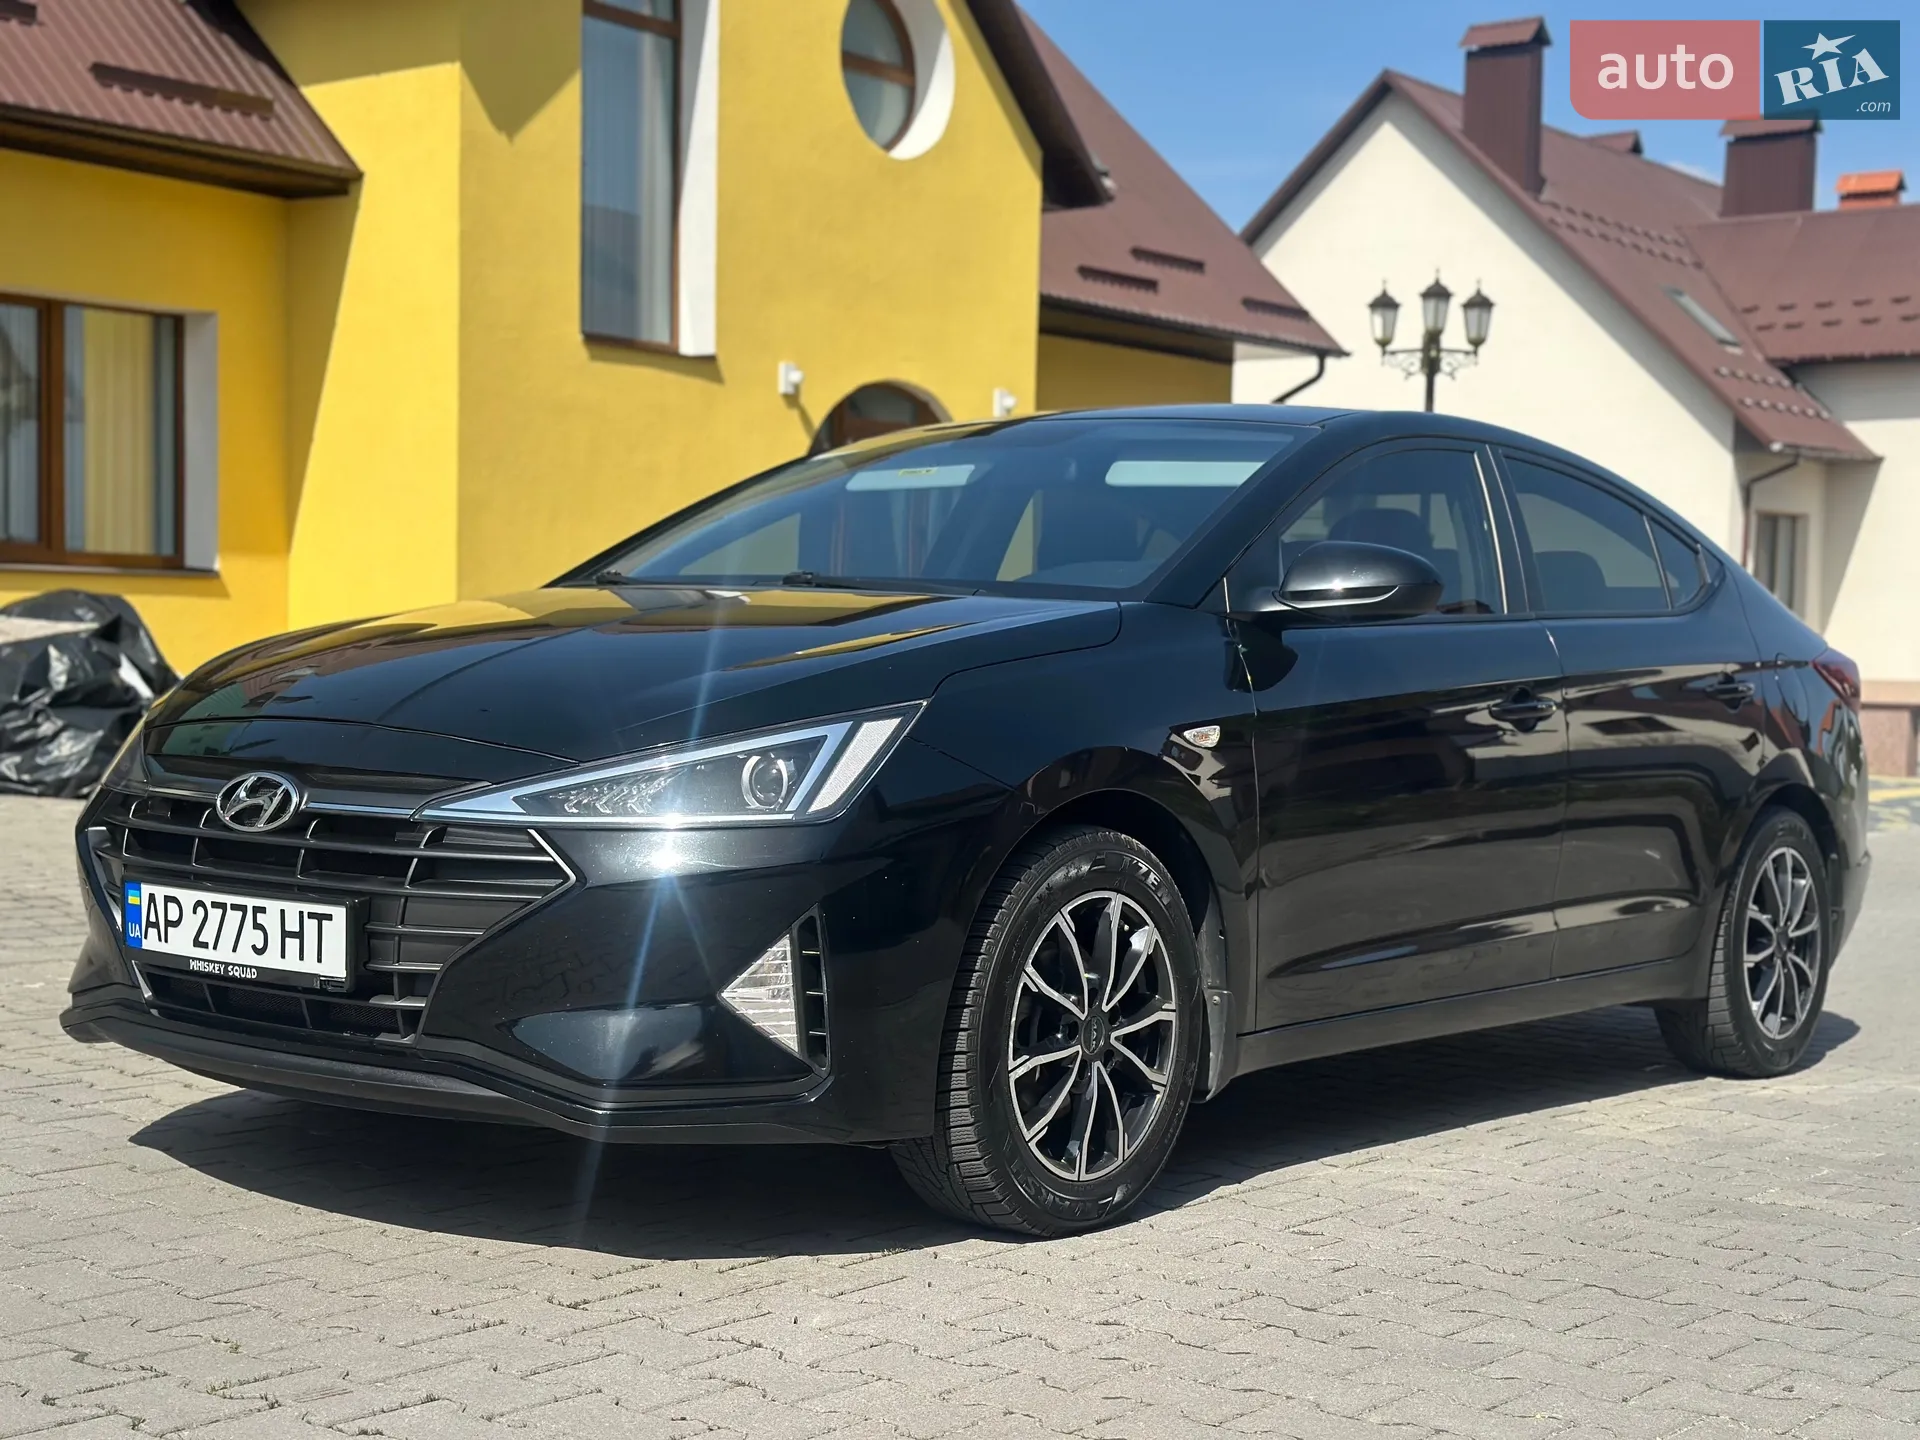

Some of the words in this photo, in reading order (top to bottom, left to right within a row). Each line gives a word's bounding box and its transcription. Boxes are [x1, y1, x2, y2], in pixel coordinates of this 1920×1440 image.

[128, 922, 141, 938] UA
[143, 892, 184, 944] AP
[192, 899, 269, 957] 2775
[280, 908, 333, 963] HT
[189, 959, 225, 975] WHISKEY
[228, 965, 258, 979] SQUAD
